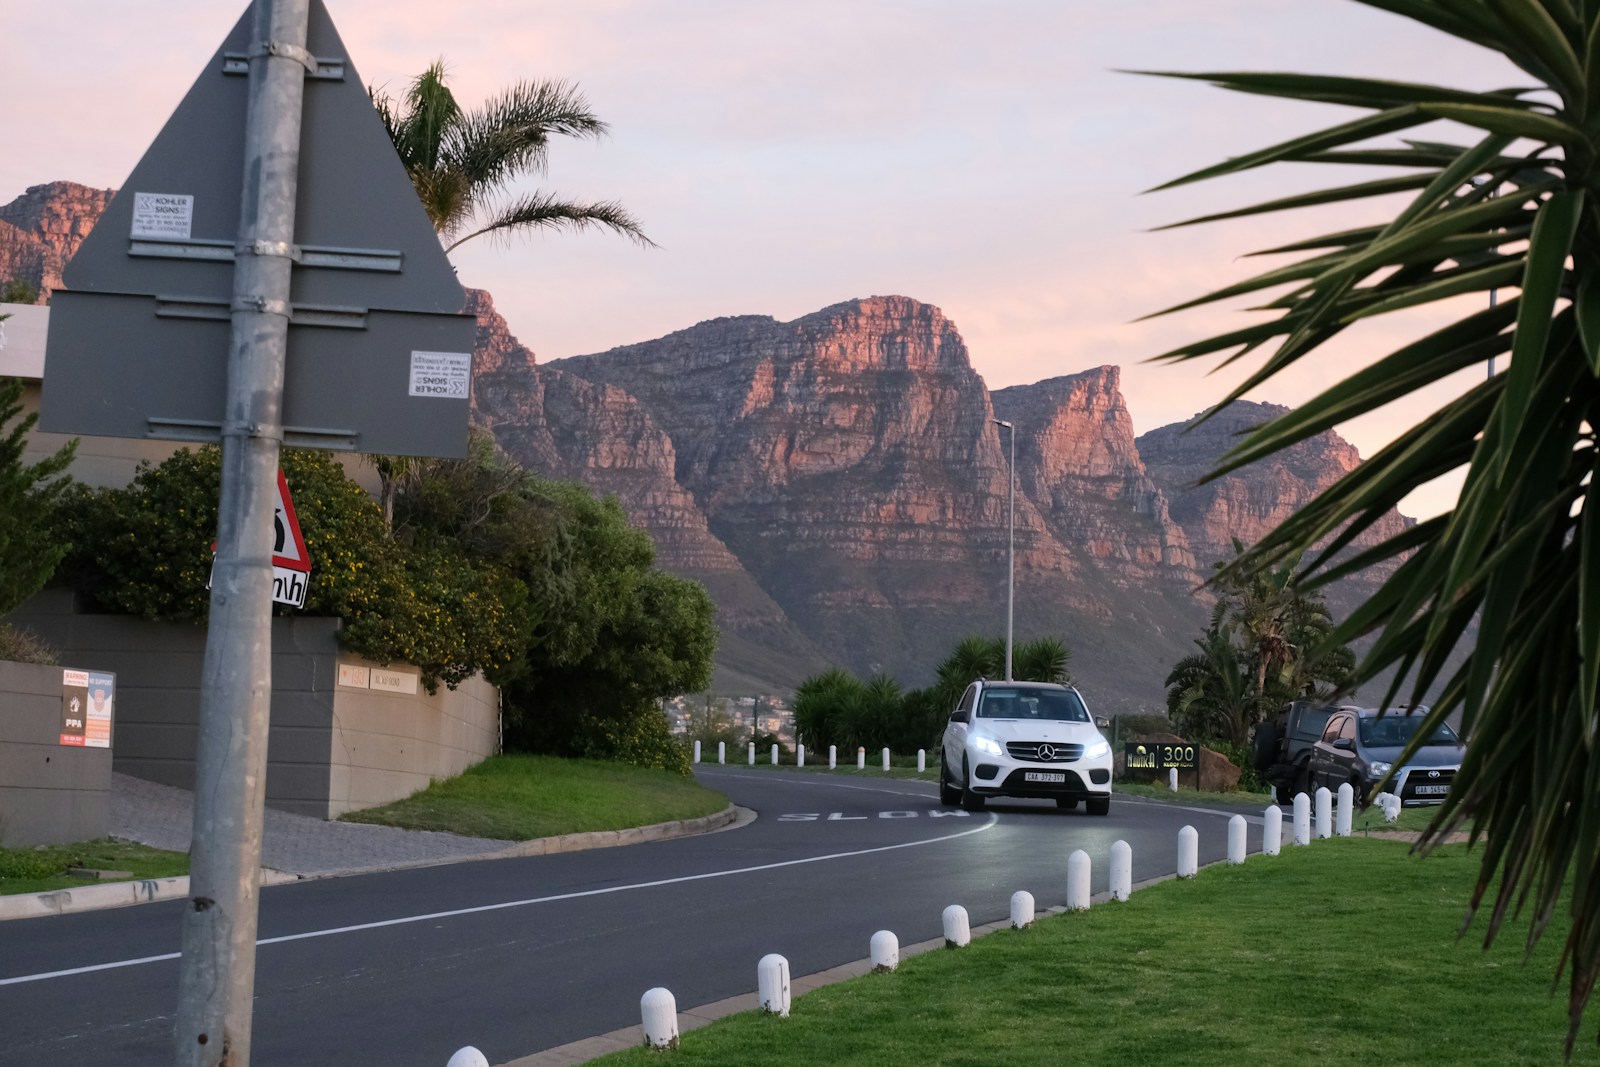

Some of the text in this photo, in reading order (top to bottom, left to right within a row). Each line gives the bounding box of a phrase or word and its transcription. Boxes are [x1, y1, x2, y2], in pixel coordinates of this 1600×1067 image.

[155, 198, 188, 206] KOHLER
[155, 206, 180, 214] SIGNS
[422, 376, 448, 386] SIGNS
[415, 385, 448, 393] KOHLER
[65, 718, 82, 728] PPA
[1164, 746, 1194, 761] 300
[777, 809, 970, 822] SLOW
